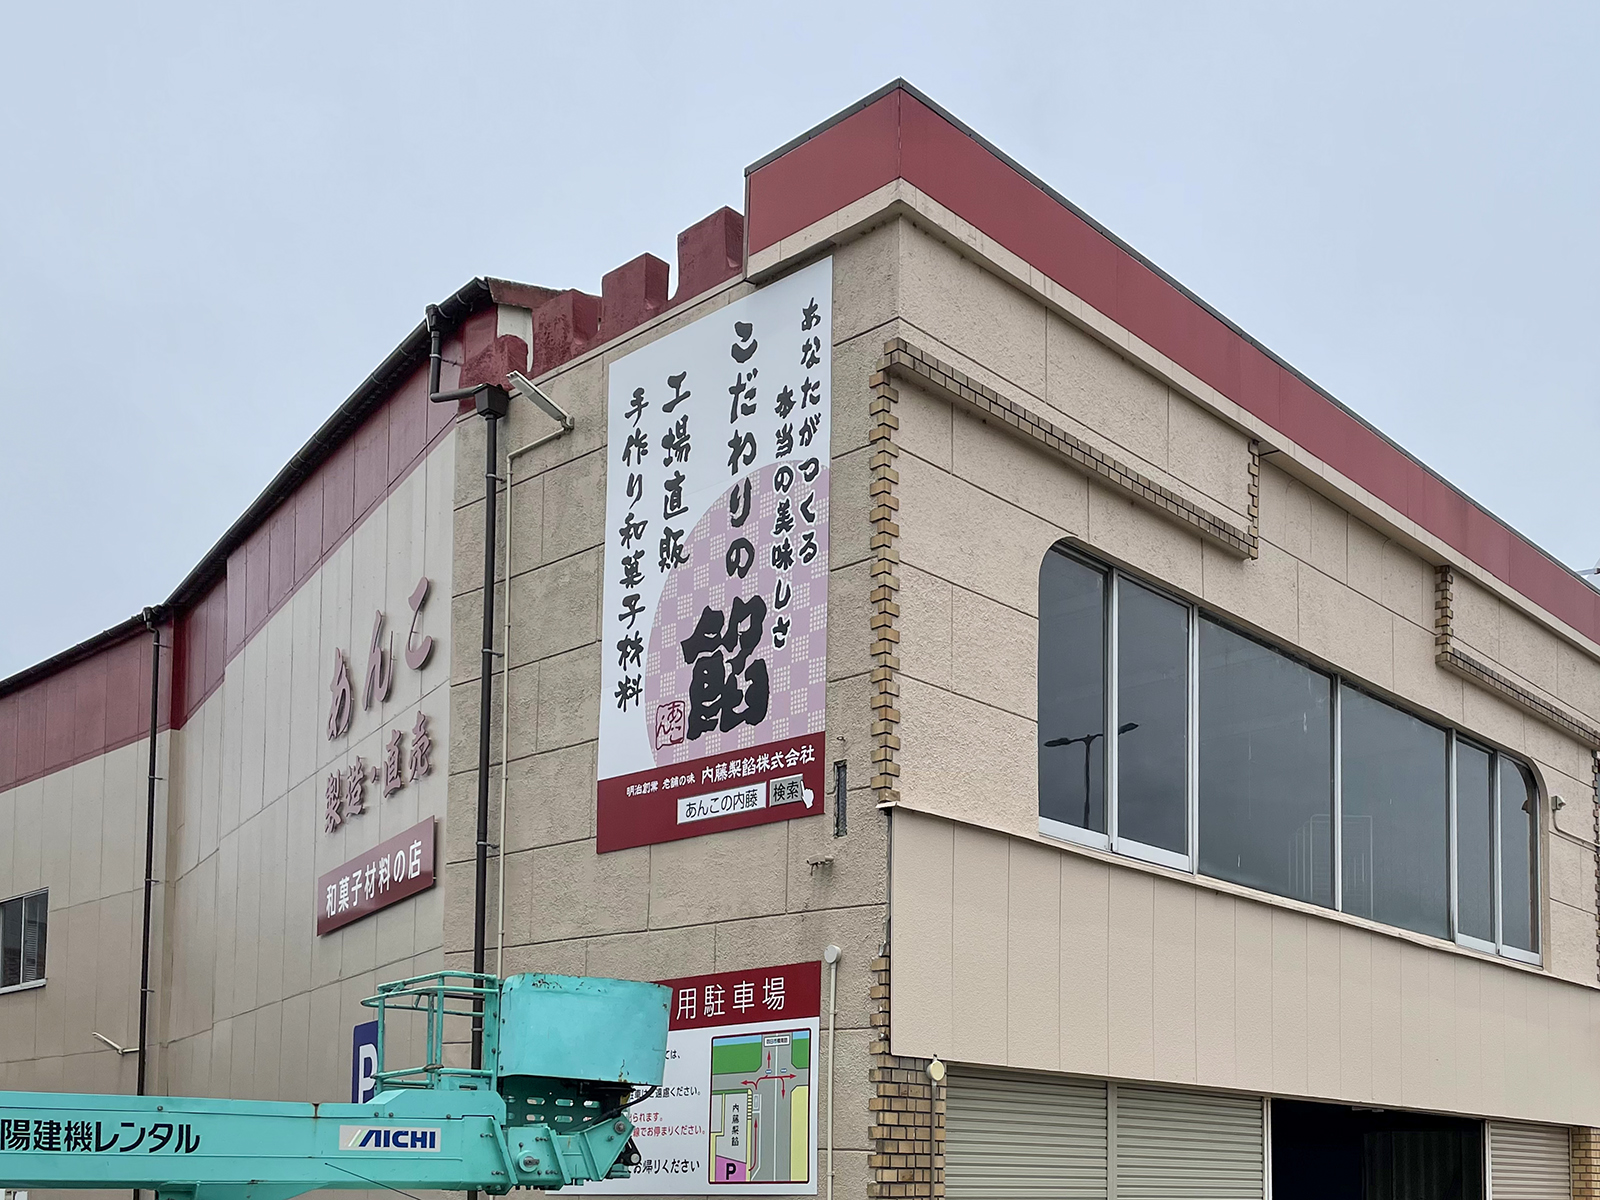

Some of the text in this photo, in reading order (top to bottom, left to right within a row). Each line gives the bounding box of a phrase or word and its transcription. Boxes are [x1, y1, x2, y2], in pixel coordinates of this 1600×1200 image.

[725, 321, 758, 579] こだわりの
[798, 297, 821, 563] あなたがつくる
[660, 371, 691, 573] 工場直販
[614, 387, 649, 712] 手作り和菓子材料
[771, 385, 796, 649] 本当の美味しさ
[326, 576, 435, 741] あんこ
[324, 710, 432, 834] 製造・直売
[626, 781, 659, 797] 明治創業
[701, 745, 816, 785] 内藤製餡株式会社
[685, 780, 800, 818] あんこの内藤 検索
[325, 839, 422, 918] 和菓子材料の店
[676, 977, 786, 1021] 用駐車場
[358, 1043, 378, 1104] P
[0, 1119, 201, 1153] 陽建機レンタル
[358, 1129, 436, 1149] AICHI
[628, 1159, 700, 1174] お帰りください
[726, 1163, 736, 1180] P
